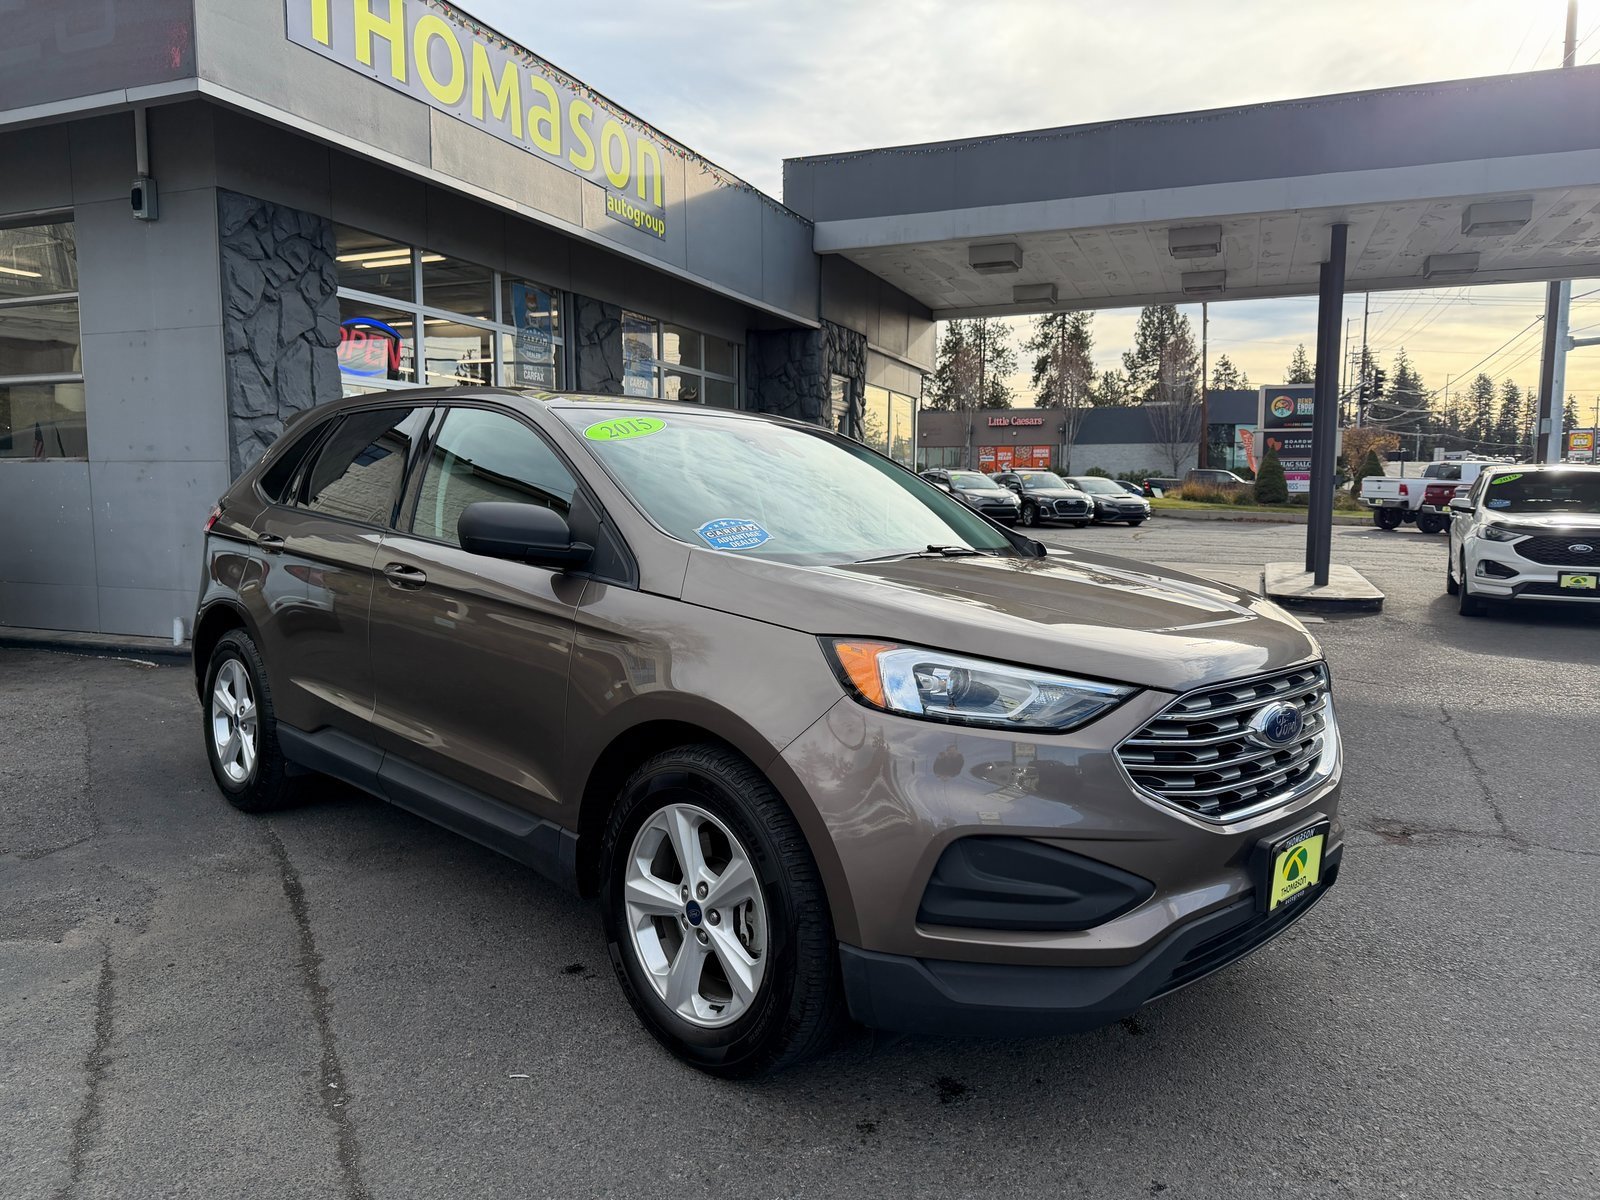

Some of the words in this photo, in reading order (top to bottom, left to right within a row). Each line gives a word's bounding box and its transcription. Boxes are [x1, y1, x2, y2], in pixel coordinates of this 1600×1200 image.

[608, 196, 665, 237] autogroup
[523, 370, 545, 382] CARFAX
[601, 418, 653, 438] 2015
[988, 417, 1010, 426] Little
[1011, 416, 1042, 426] Caesars
[705, 524, 759, 539] CARFAX
[716, 531, 762, 544] ADVANTAGE
[730, 537, 761, 548] DEALER
[1276, 711, 1298, 738] Ford
